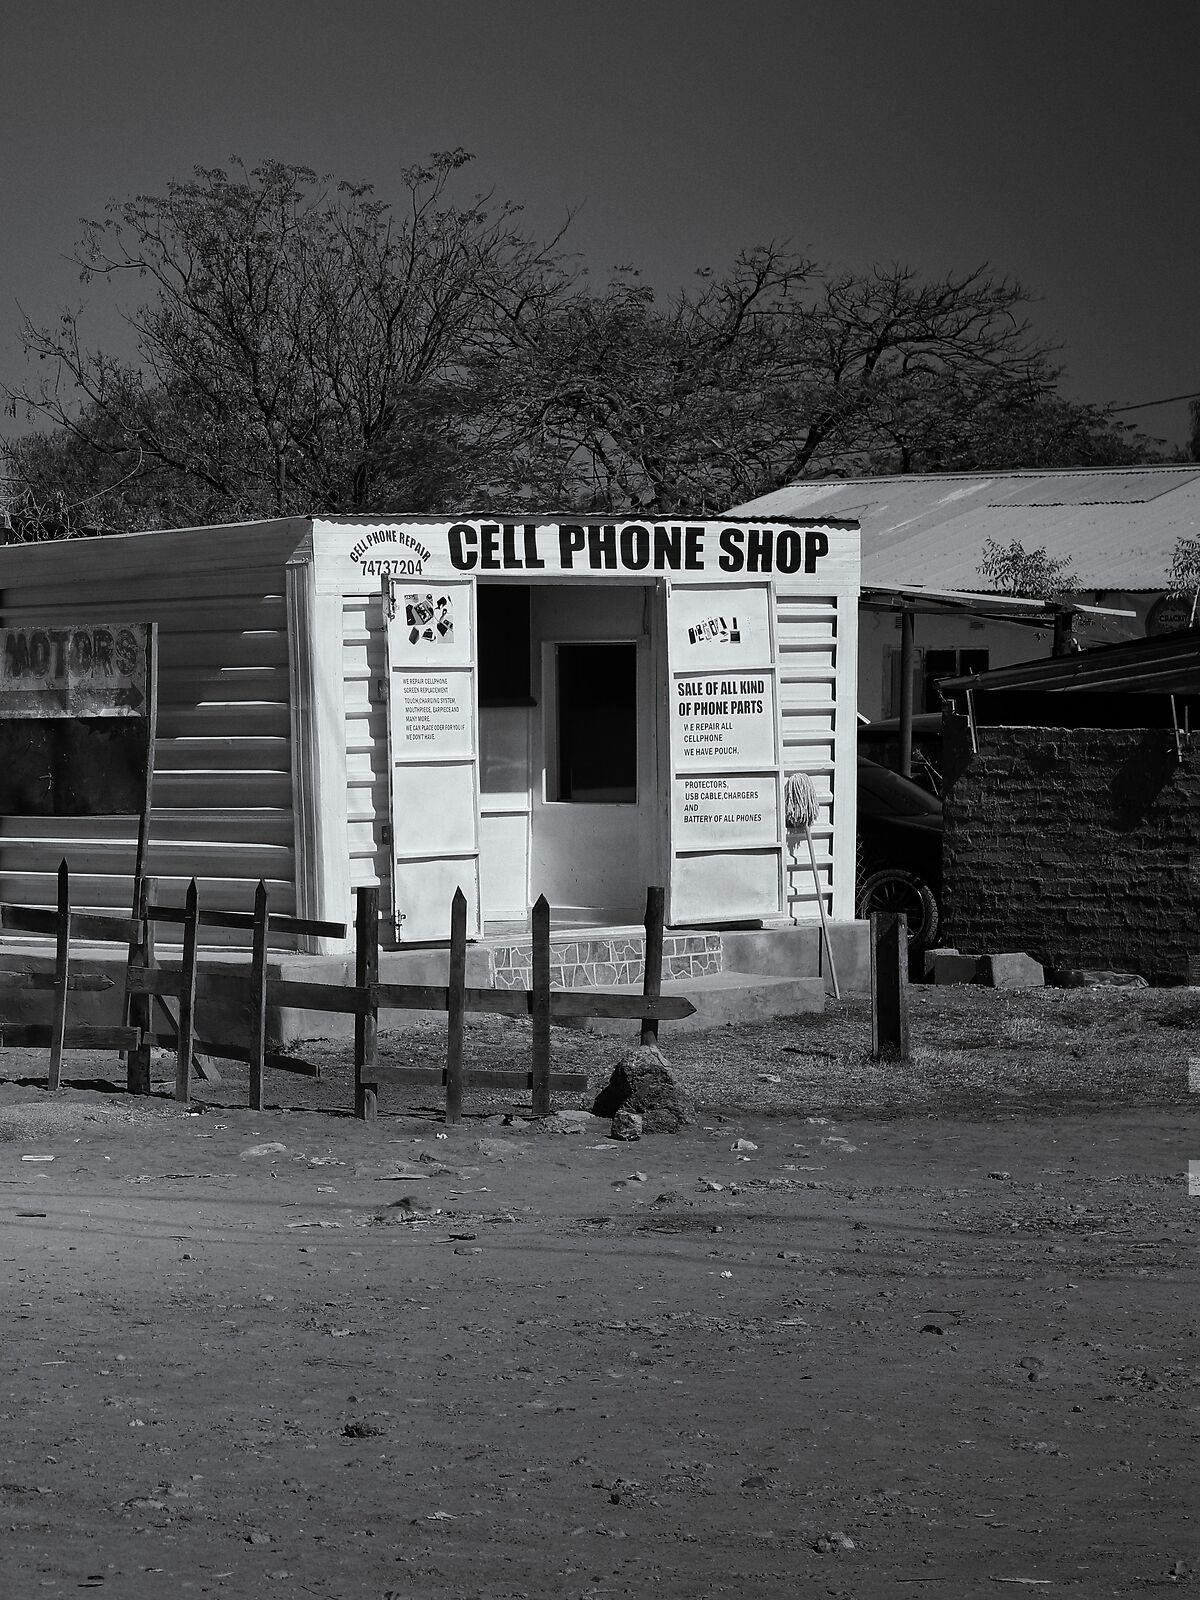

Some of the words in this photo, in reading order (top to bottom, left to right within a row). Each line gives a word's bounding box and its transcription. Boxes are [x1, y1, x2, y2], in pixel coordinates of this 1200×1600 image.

[350, 540, 368, 563] CELL
[366, 530, 397, 546] PHONE
[400, 532, 431, 562] REPAIR
[447, 524, 545, 570] CELL
[558, 525, 706, 570] PHONE
[718, 528, 829, 574] SHOP
[360, 560, 422, 576] 74737204
[5, 629, 138, 679] MOTORS
[678, 682, 703, 696] SALE
[706, 682, 718, 695] OF
[721, 681, 738, 695] ALL
[740, 680, 764, 694] KIND
[678, 702, 691, 716] OF
[694, 702, 728, 716] PHONE
[731, 700, 763, 714] PARTS
[684, 734, 722, 742] CELLPHONE
